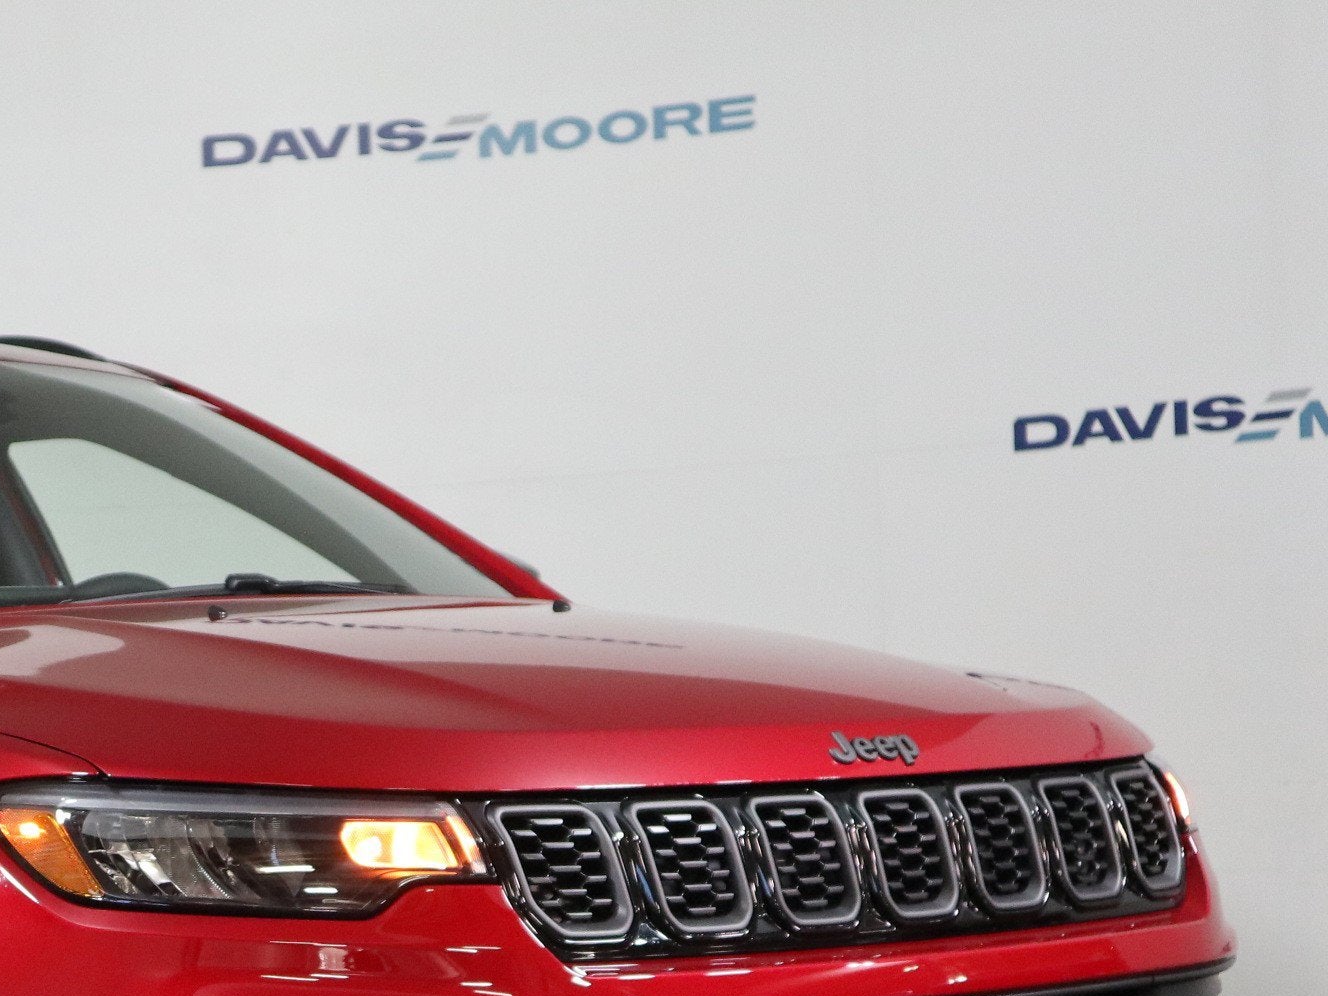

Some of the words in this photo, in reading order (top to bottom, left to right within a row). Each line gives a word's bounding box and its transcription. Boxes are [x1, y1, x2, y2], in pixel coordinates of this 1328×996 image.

[202, 119, 427, 168] DAVIS
[478, 95, 756, 157] MOORE
[1013, 394, 1246, 452] DAVIS
[829, 731, 920, 767] Jeep
